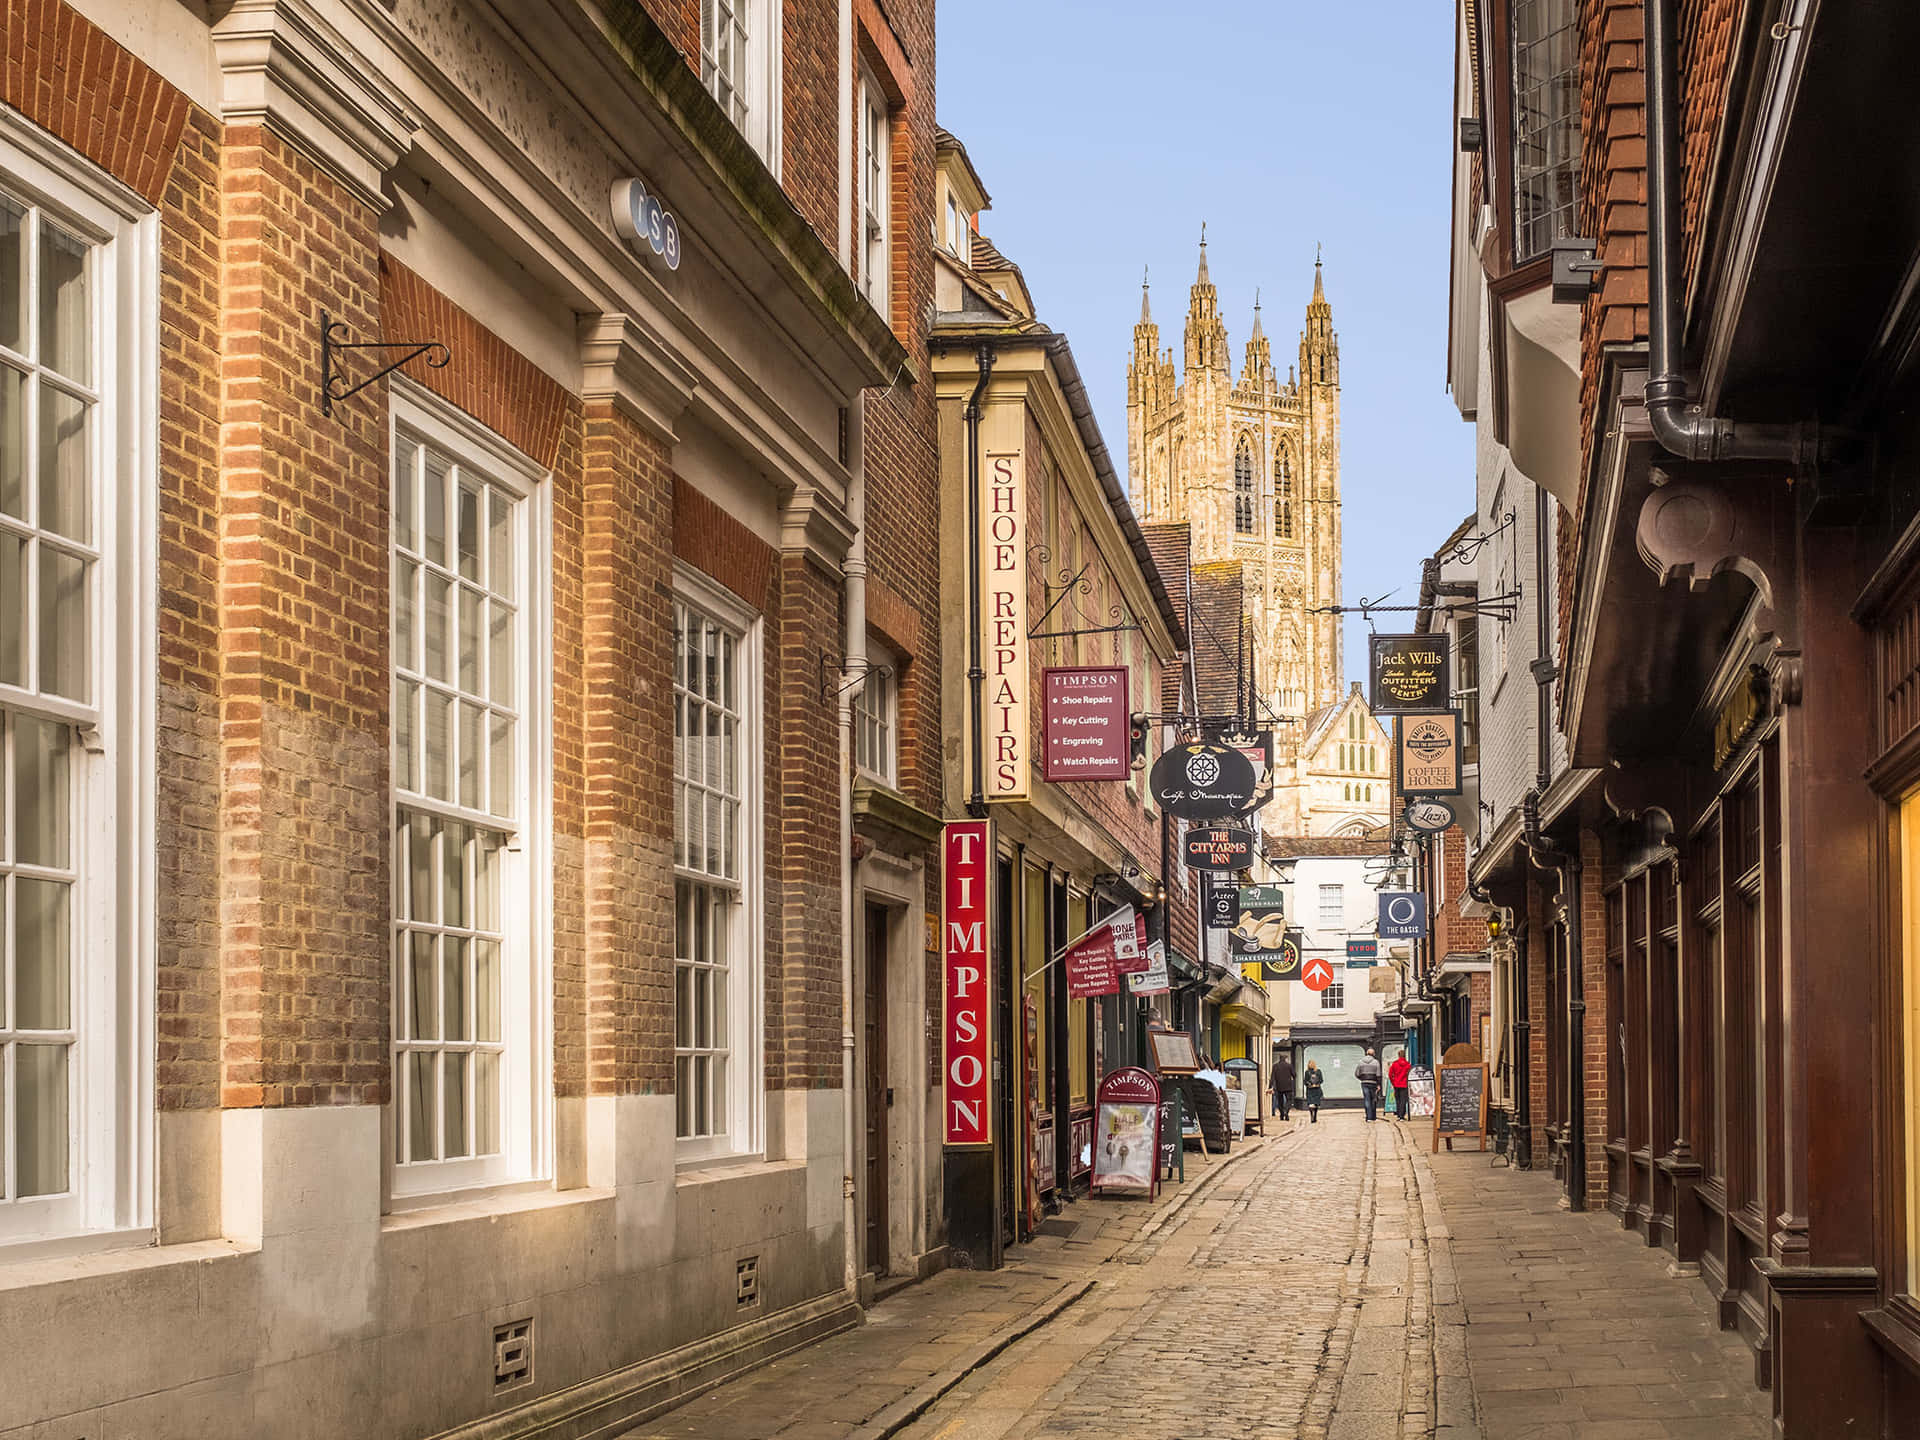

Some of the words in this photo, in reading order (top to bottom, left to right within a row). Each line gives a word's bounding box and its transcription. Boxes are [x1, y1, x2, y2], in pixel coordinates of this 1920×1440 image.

[992, 458, 1016, 571] SHOE
[1377, 652, 1406, 669] Jack
[1408, 652, 1442, 665] Wills
[1054, 675, 1118, 686] TIMPSON
[1381, 677, 1437, 685] OUTFITTERS
[993, 591, 1019, 792] REPAIRS
[1390, 686, 1428, 698] GENTRY
[1062, 696, 1081, 705] Shoe
[1083, 695, 1113, 705] Repairs
[1062, 717, 1077, 727] Key
[1078, 716, 1109, 726] Cutting
[1062, 737, 1103, 747] Engraving
[1062, 757, 1088, 767] Watch
[1089, 756, 1119, 767] Repairs
[1407, 766, 1451, 776] COFFEE
[1408, 776, 1452, 786] HOUSE
[1209, 831, 1229, 842] THE
[1189, 842, 1217, 854] CITY
[1216, 842, 1247, 854] ARMS
[1211, 854, 1230, 865] INN
[1386, 926, 1399, 934] THE
[1400, 926, 1419, 934] OASIS
[948, 832, 985, 1132] TIMPSON
[1106, 1076, 1152, 1091] TIMPSON
